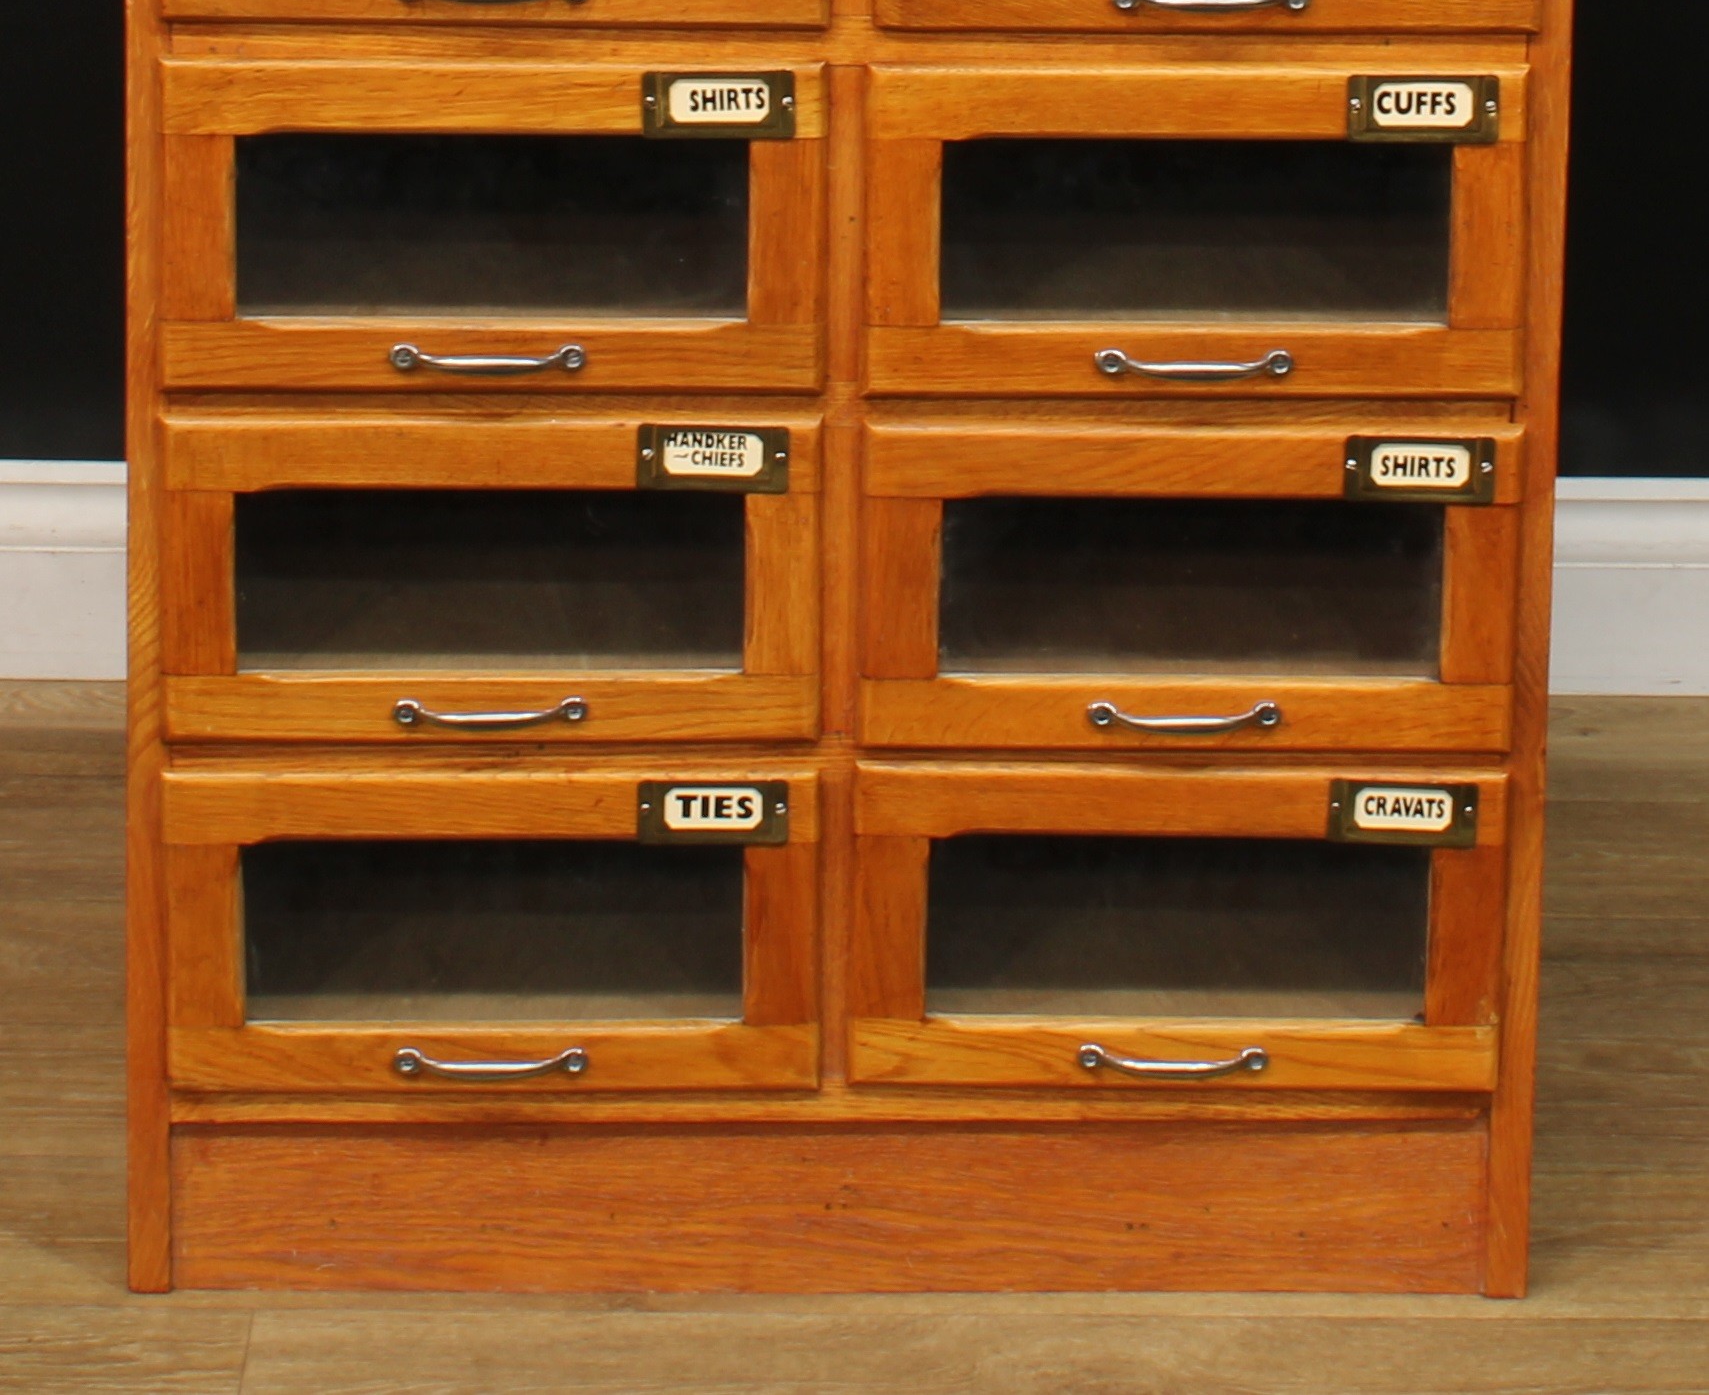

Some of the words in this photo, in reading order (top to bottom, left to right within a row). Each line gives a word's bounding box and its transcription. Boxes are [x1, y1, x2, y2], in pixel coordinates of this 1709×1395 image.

[689, 87, 765, 112] SHIRTS
[1376, 91, 1457, 116] CUFFS
[666, 432, 747, 449] HANDKER
[1379, 455, 1456, 478] SHIRTS
[675, 794, 754, 820] TIES
[1363, 795, 1445, 819] CRAVATS
